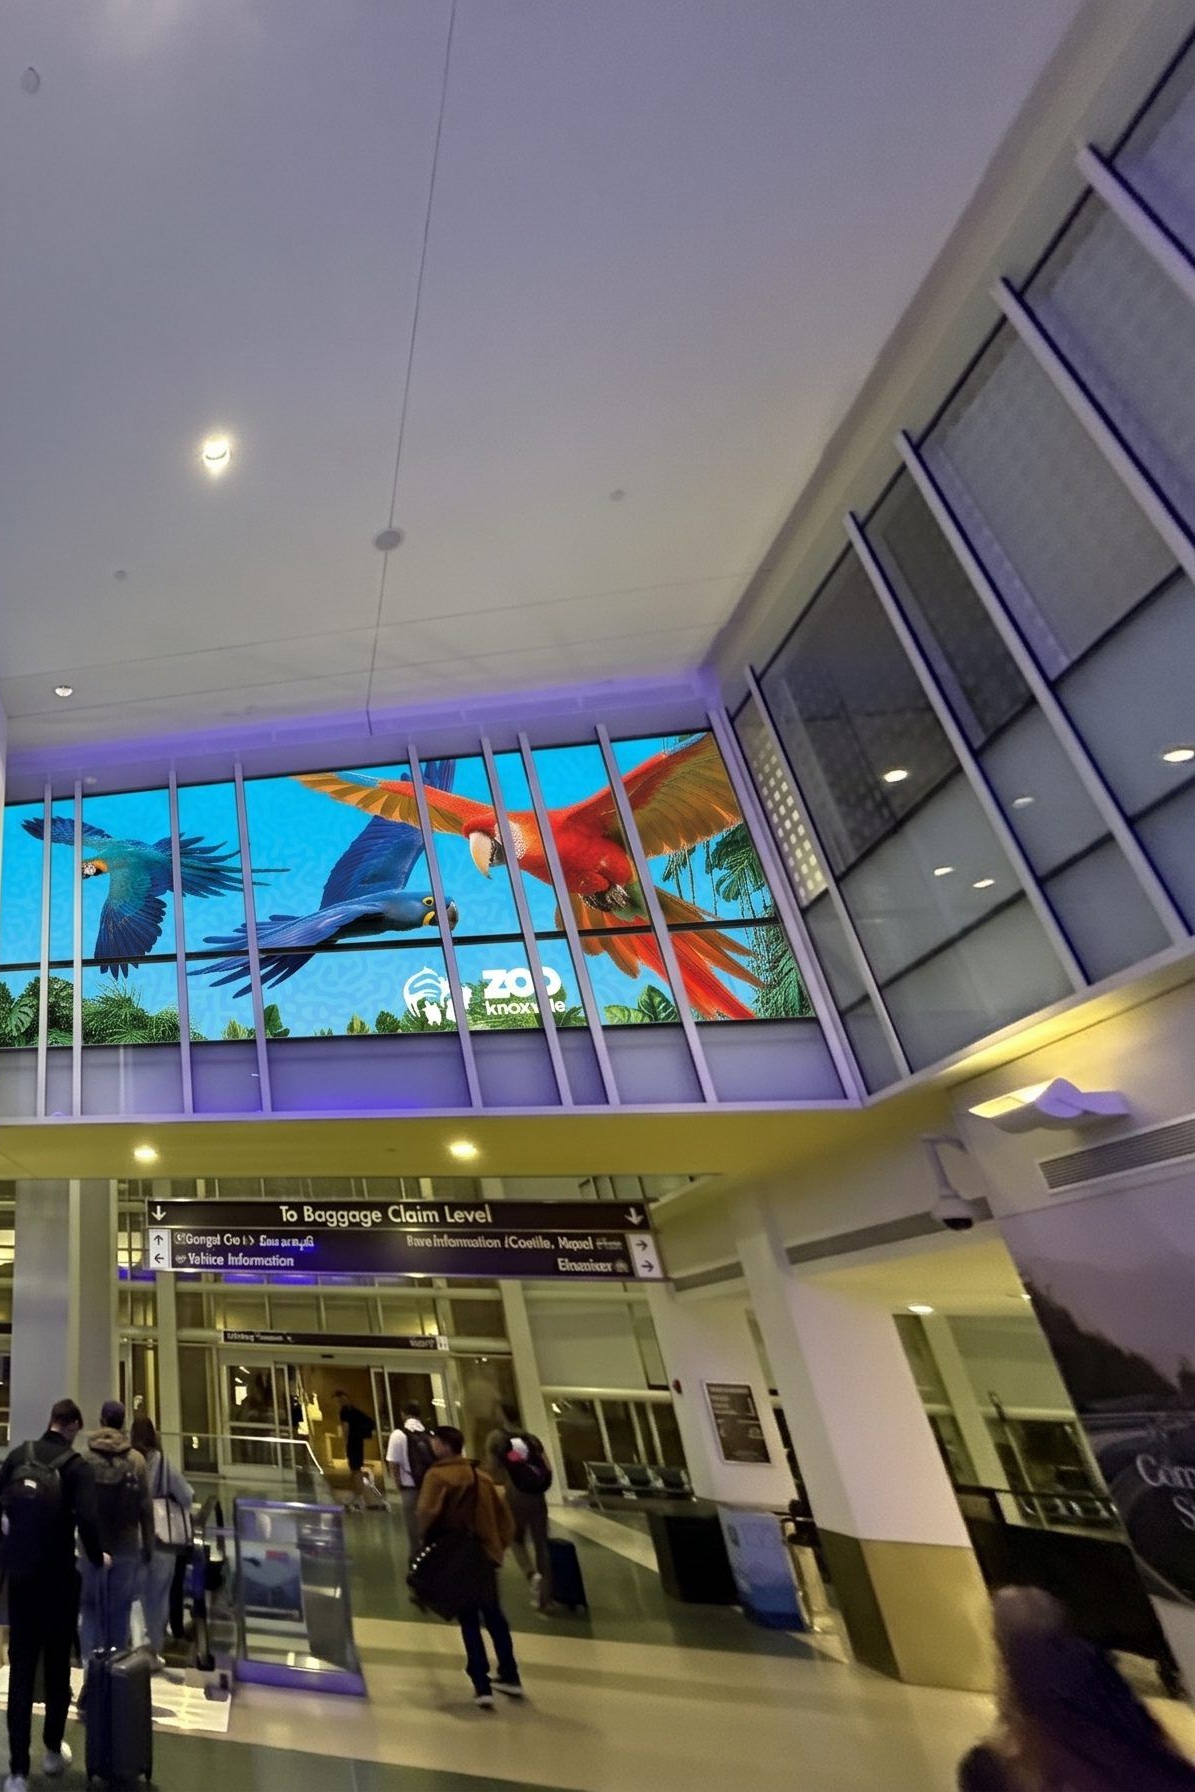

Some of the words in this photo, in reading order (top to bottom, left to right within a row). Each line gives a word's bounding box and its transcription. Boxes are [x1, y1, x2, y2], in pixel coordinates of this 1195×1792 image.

[280, 1205, 298, 1222] To
[303, 1205, 382, 1228] Baggage
[388, 1204, 440, 1223] Claim
[445, 1203, 493, 1223] Level
